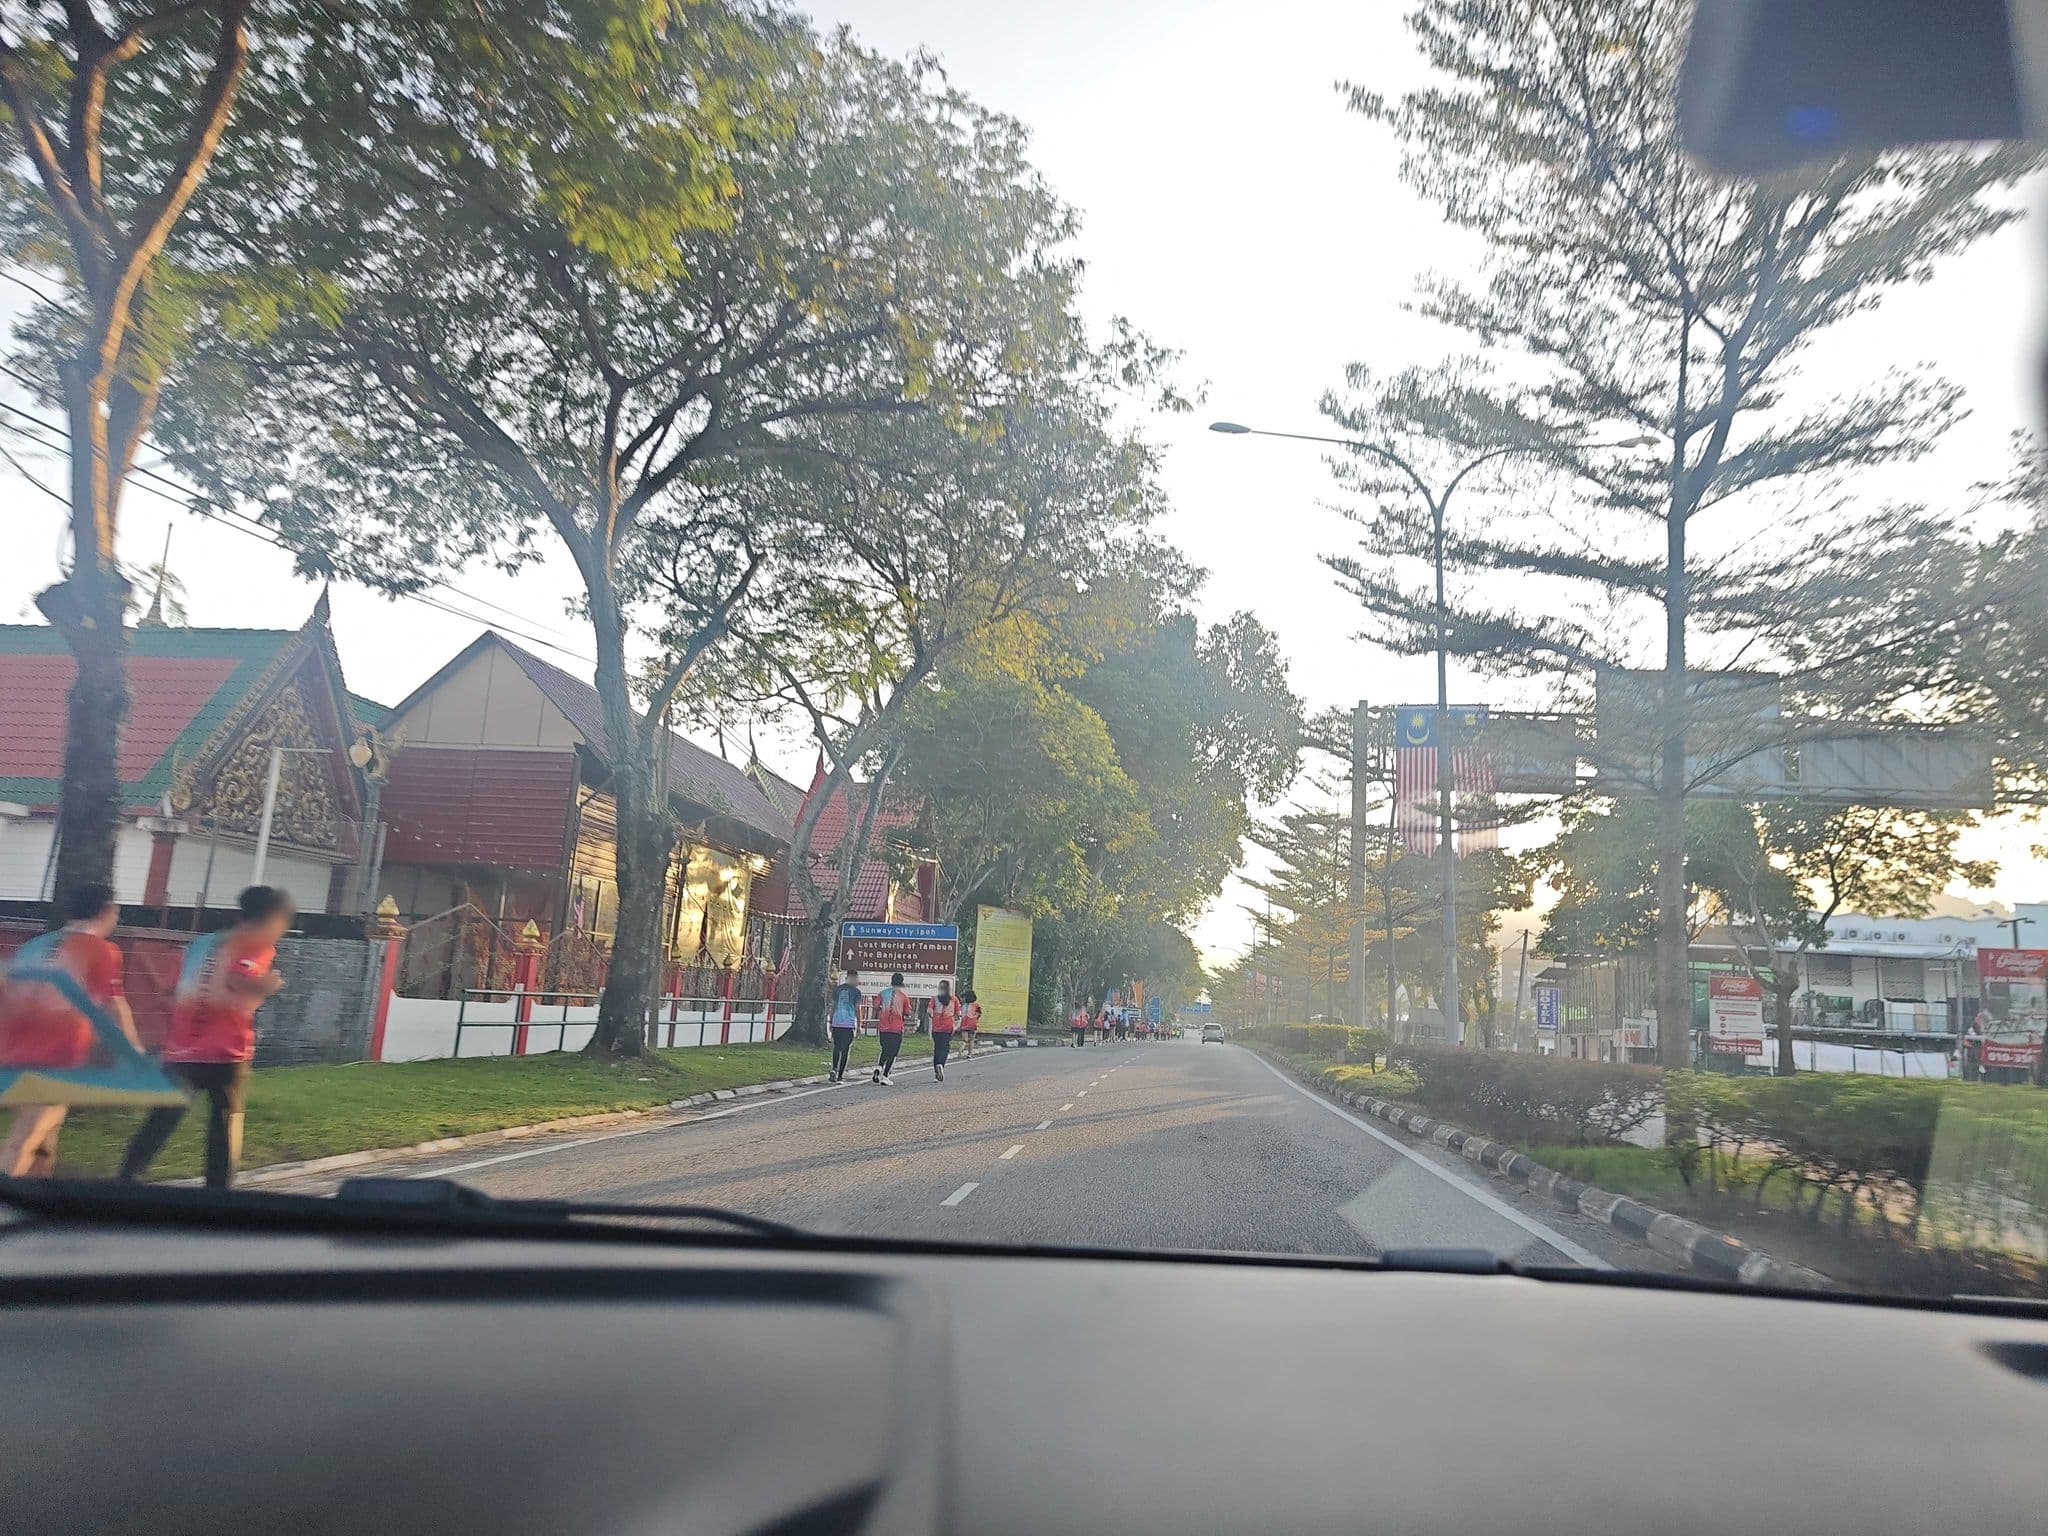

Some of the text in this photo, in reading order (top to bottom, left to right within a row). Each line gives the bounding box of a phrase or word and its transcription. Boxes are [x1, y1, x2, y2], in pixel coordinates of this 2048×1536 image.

[860, 926, 936, 937] Sunway City Ipoh
[858, 941, 953, 951] Lost World of Tambun
[858, 951, 918, 960] The Banjaran
[862, 961, 949, 971] Hotsprings Retreat
